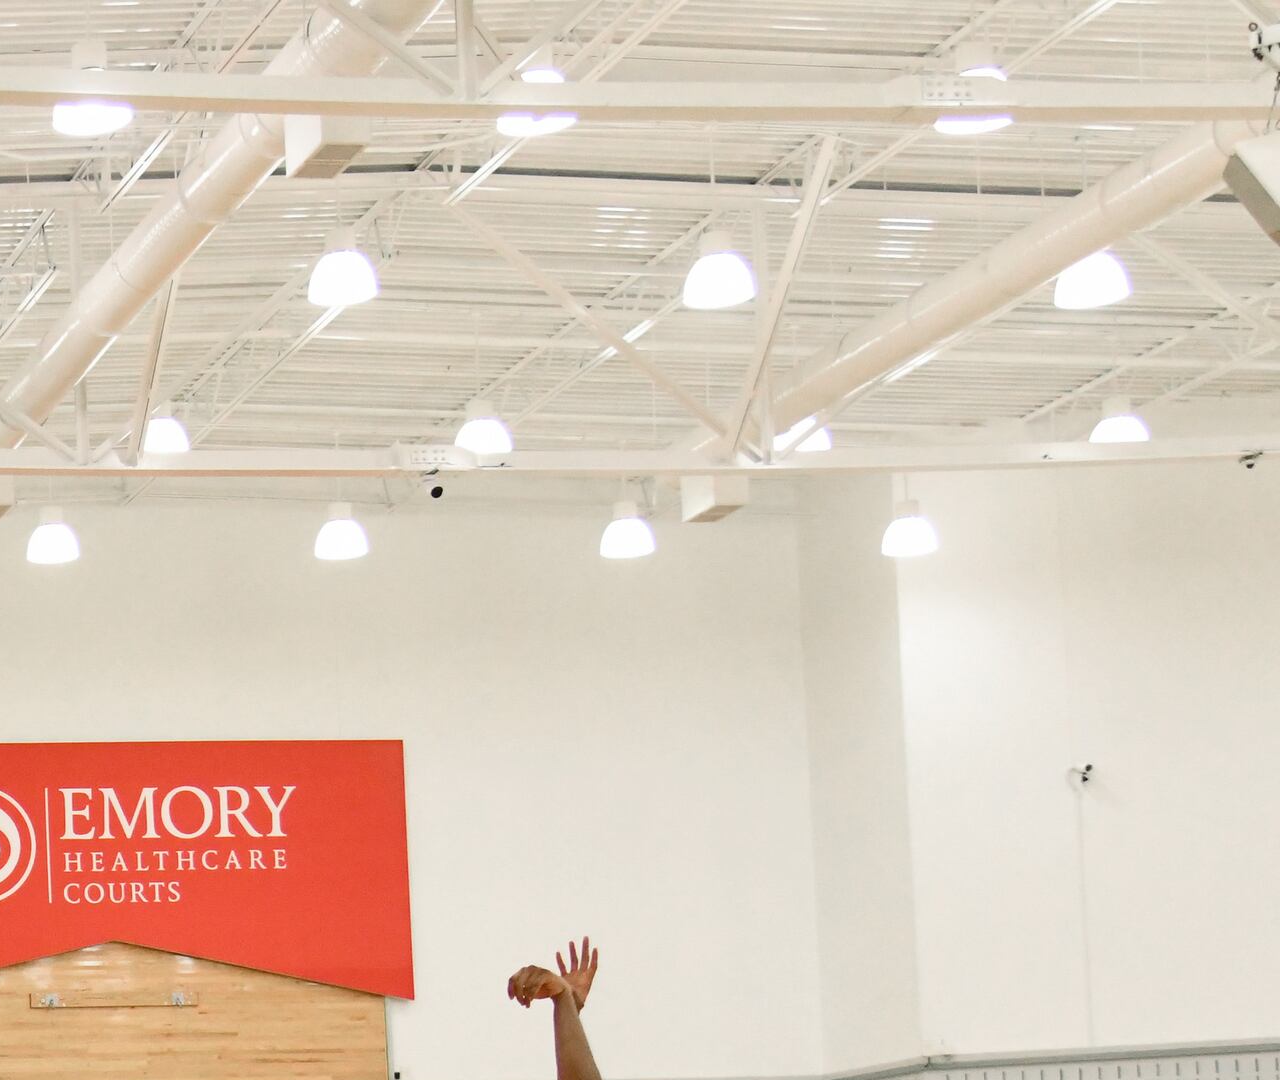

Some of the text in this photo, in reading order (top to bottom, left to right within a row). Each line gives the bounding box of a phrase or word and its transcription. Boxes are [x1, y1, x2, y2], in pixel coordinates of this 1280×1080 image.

[58, 785, 297, 840] EMORY
[63, 849, 288, 872] HEALTHCARE
[63, 881, 181, 904] COURTS
